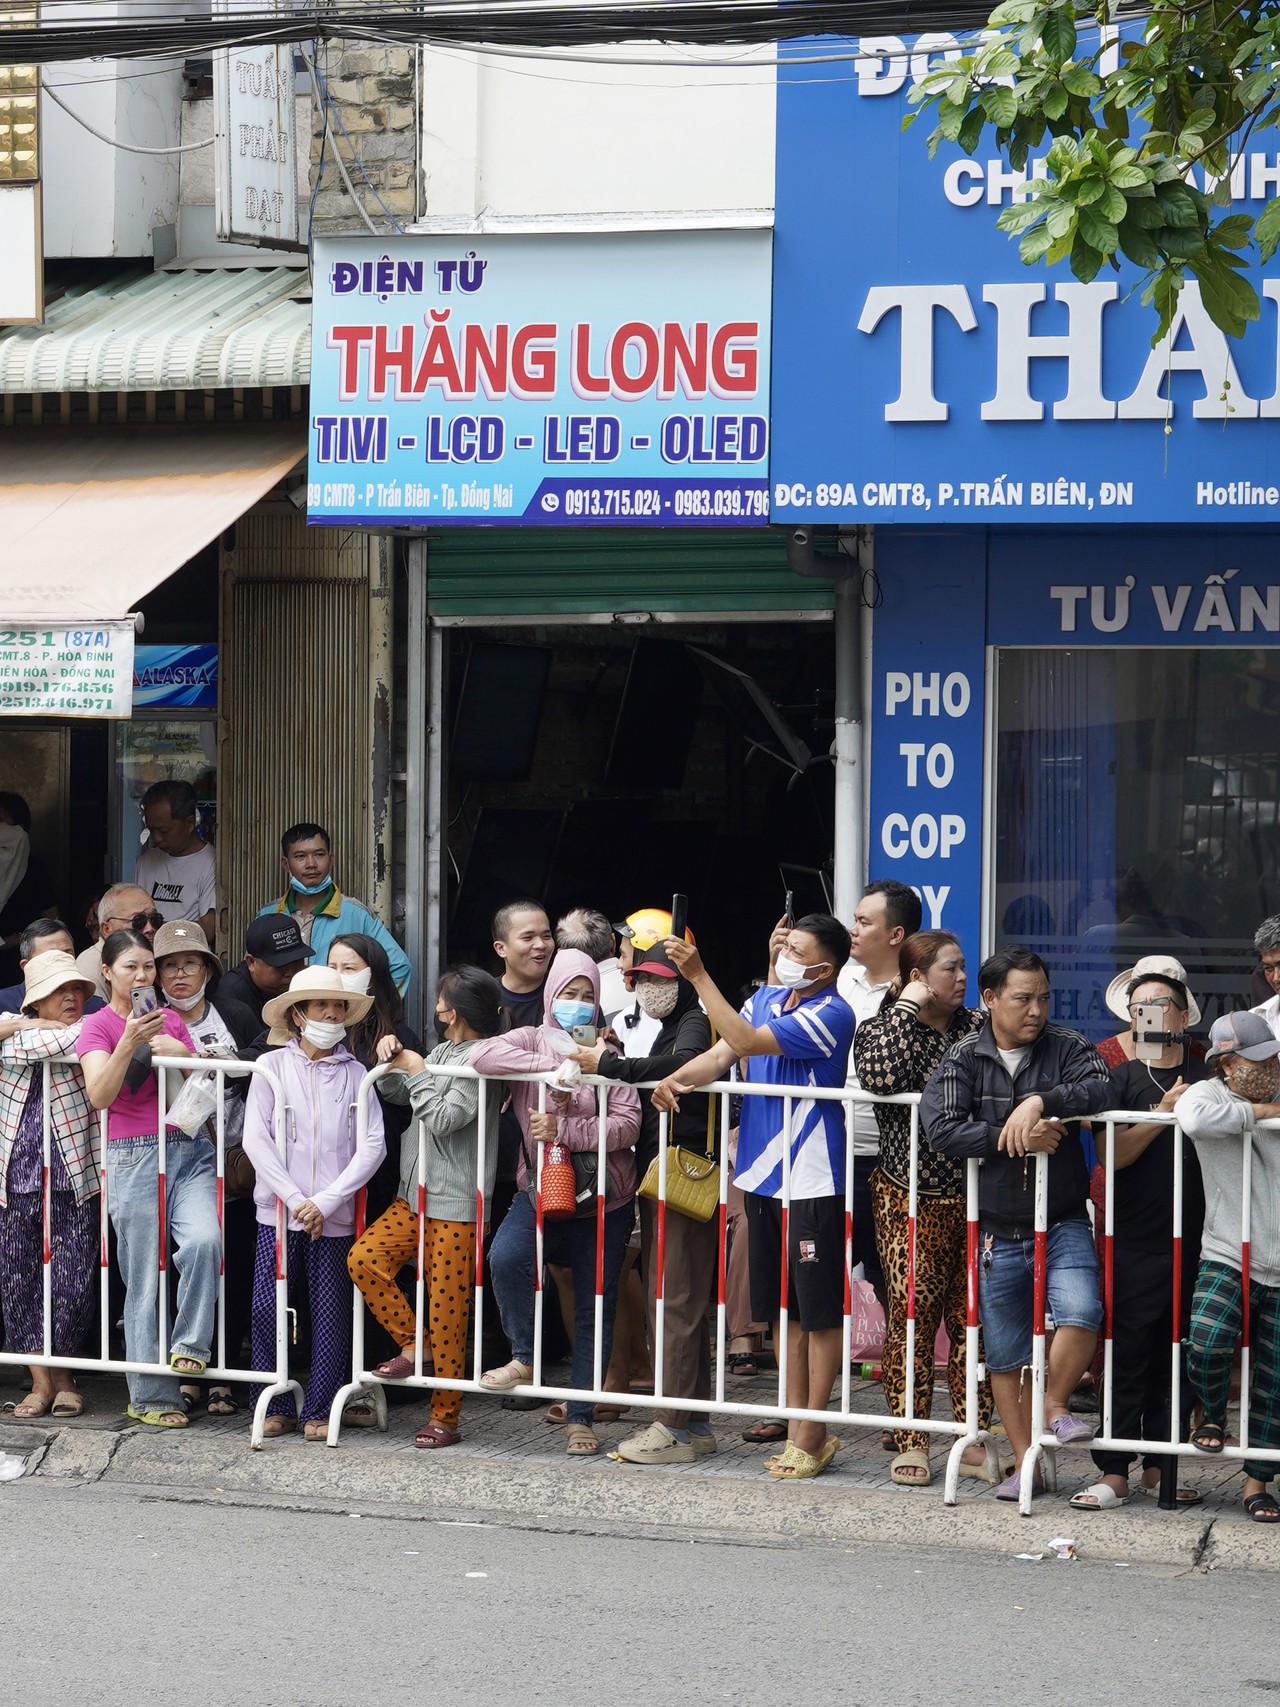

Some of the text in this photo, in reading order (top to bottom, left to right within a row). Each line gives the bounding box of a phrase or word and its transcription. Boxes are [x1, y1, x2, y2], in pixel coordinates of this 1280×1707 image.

[331, 251, 488, 304] ĐIỆN TỬ
[328, 308, 760, 402] THĂNG LONG
[857, 279, 1280, 422] THA
[314, 415, 388, 463] TIVI
[426, 415, 506, 463] LCD
[544, 415, 621, 463] LED
[660, 415, 768, 464] OLED
[324, 483, 355, 507] CMT8
[366, 484, 374, 507] P
[377, 479, 401, 507] Trấn
[404, 483, 430, 508] Biên
[441, 483, 458, 510] Tp.
[493, 483, 513, 508] Nai
[565, 489, 661, 516] 0913.715.024
[674, 489, 769, 516] 0983.039.796
[774, 474, 1134, 511] ĐC: 89A CMT8, P.TRẤN BIÊN, ĐN
[1196, 481, 1279, 506] Hotline
[1050, 568, 1280, 633] TƯ VẤN
[42, 651, 53, 661] P.
[57, 649, 82, 662] HÒA
[64, 631, 111, 649] (87A)
[23, 665, 48, 678] HÒA
[95, 668, 115, 679] NAI
[140, 666, 211, 686] ALASKA
[886, 671, 971, 718] PHO
[899, 742, 954, 788] TO
[881, 812, 966, 859] COP
[916, 885, 951, 929] Y
[860, 1291, 878, 1305] NO
[855, 1332, 883, 1346] BAG
[858, 1319, 886, 1334] PLAS
